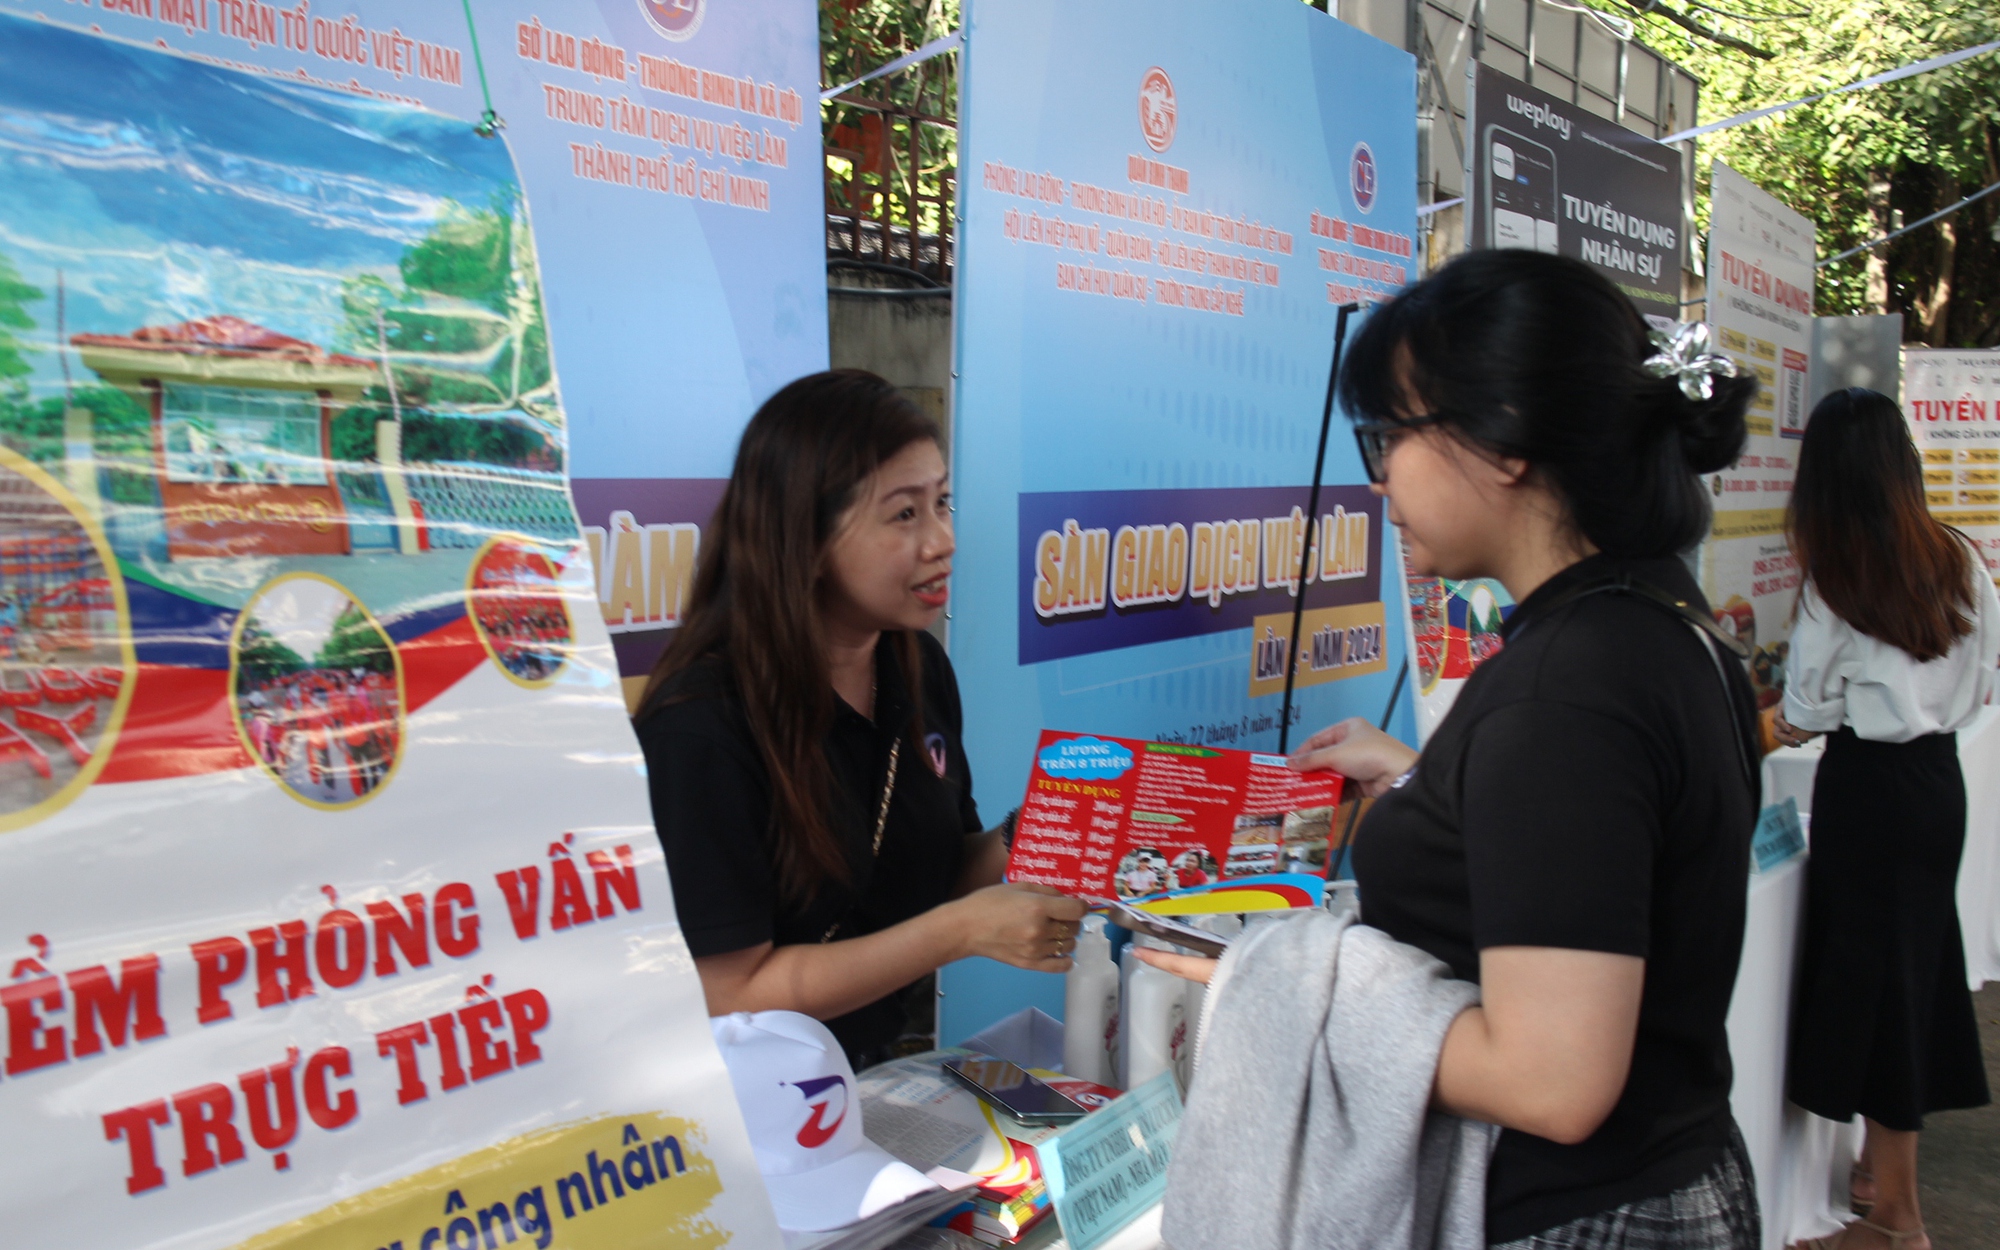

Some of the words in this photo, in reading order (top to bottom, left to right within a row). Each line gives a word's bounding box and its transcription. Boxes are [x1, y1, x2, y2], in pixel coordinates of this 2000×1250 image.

[217, 0, 276, 50] TRẬN
[281, 3, 309, 52] TỔ
[314, 15, 368, 67] QUỐC
[371, 28, 414, 80] VIỆT
[418, 42, 463, 87] NAM
[517, 14, 542, 61] SỞ
[546, 29, 576, 70] LAO
[580, 35, 626, 84] ĐỘNG
[637, 51, 699, 100] THƯƠNG
[702, 70, 736, 109] BINH
[738, 75, 757, 115] VÀ
[758, 81, 778, 120] XÃ
[779, 86, 803, 132] HỘI
[542, 82, 605, 129] TRUNG
[608, 93, 647, 139] TÂM
[650, 107, 690, 150] DỊCH
[692, 117, 715, 160] VỤ
[716, 120, 752, 166] VIỆC
[754, 127, 787, 168] LÀM
[1507, 93, 1571, 141] weploy
[569, 141, 633, 188] THÀNH
[636, 152, 673, 194] PHỐ
[673, 157, 696, 199] HỒ
[700, 166, 726, 205] CHÍ
[729, 173, 770, 213] MINH
[1581, 237, 1635, 274] NHÂN
[1637, 252, 1662, 285] SỰ
[1628, 221, 1676, 249] DỤNG
[1721, 250, 1772, 300] TUYỂN
[1774, 276, 1810, 315] DỤNG
[1912, 391, 1987, 422] TUYỂN
[1033, 518, 1110, 618] SÀN
[1112, 521, 1189, 609] GIAO
[1190, 519, 1261, 608] DỊCH
[1320, 504, 1369, 582] LÀM
[1255, 626, 1286, 681] LẦN
[1310, 623, 1344, 672] NĂM
[1344, 623, 1381, 666] 2024
[1060, 745, 1110, 756] LƯƠNG
[1206, 720, 1238, 744] tháng
[1239, 715, 1249, 737] 8
[1251, 714, 1273, 734] năm
[1040, 757, 1077, 770] TRÊN
[1078, 760, 1087, 769] 8
[1090, 758, 1131, 770] TRIỆU
[1083, 786, 1121, 799] DỤNG
[189, 883, 481, 1025] PHỎNG
[495, 831, 643, 940] VẤN
[102, 1044, 358, 1196] TRỰC
[376, 973, 551, 1105] TIẾP
[420, 1188, 552, 1250] công
[556, 1123, 687, 1219] nhân
